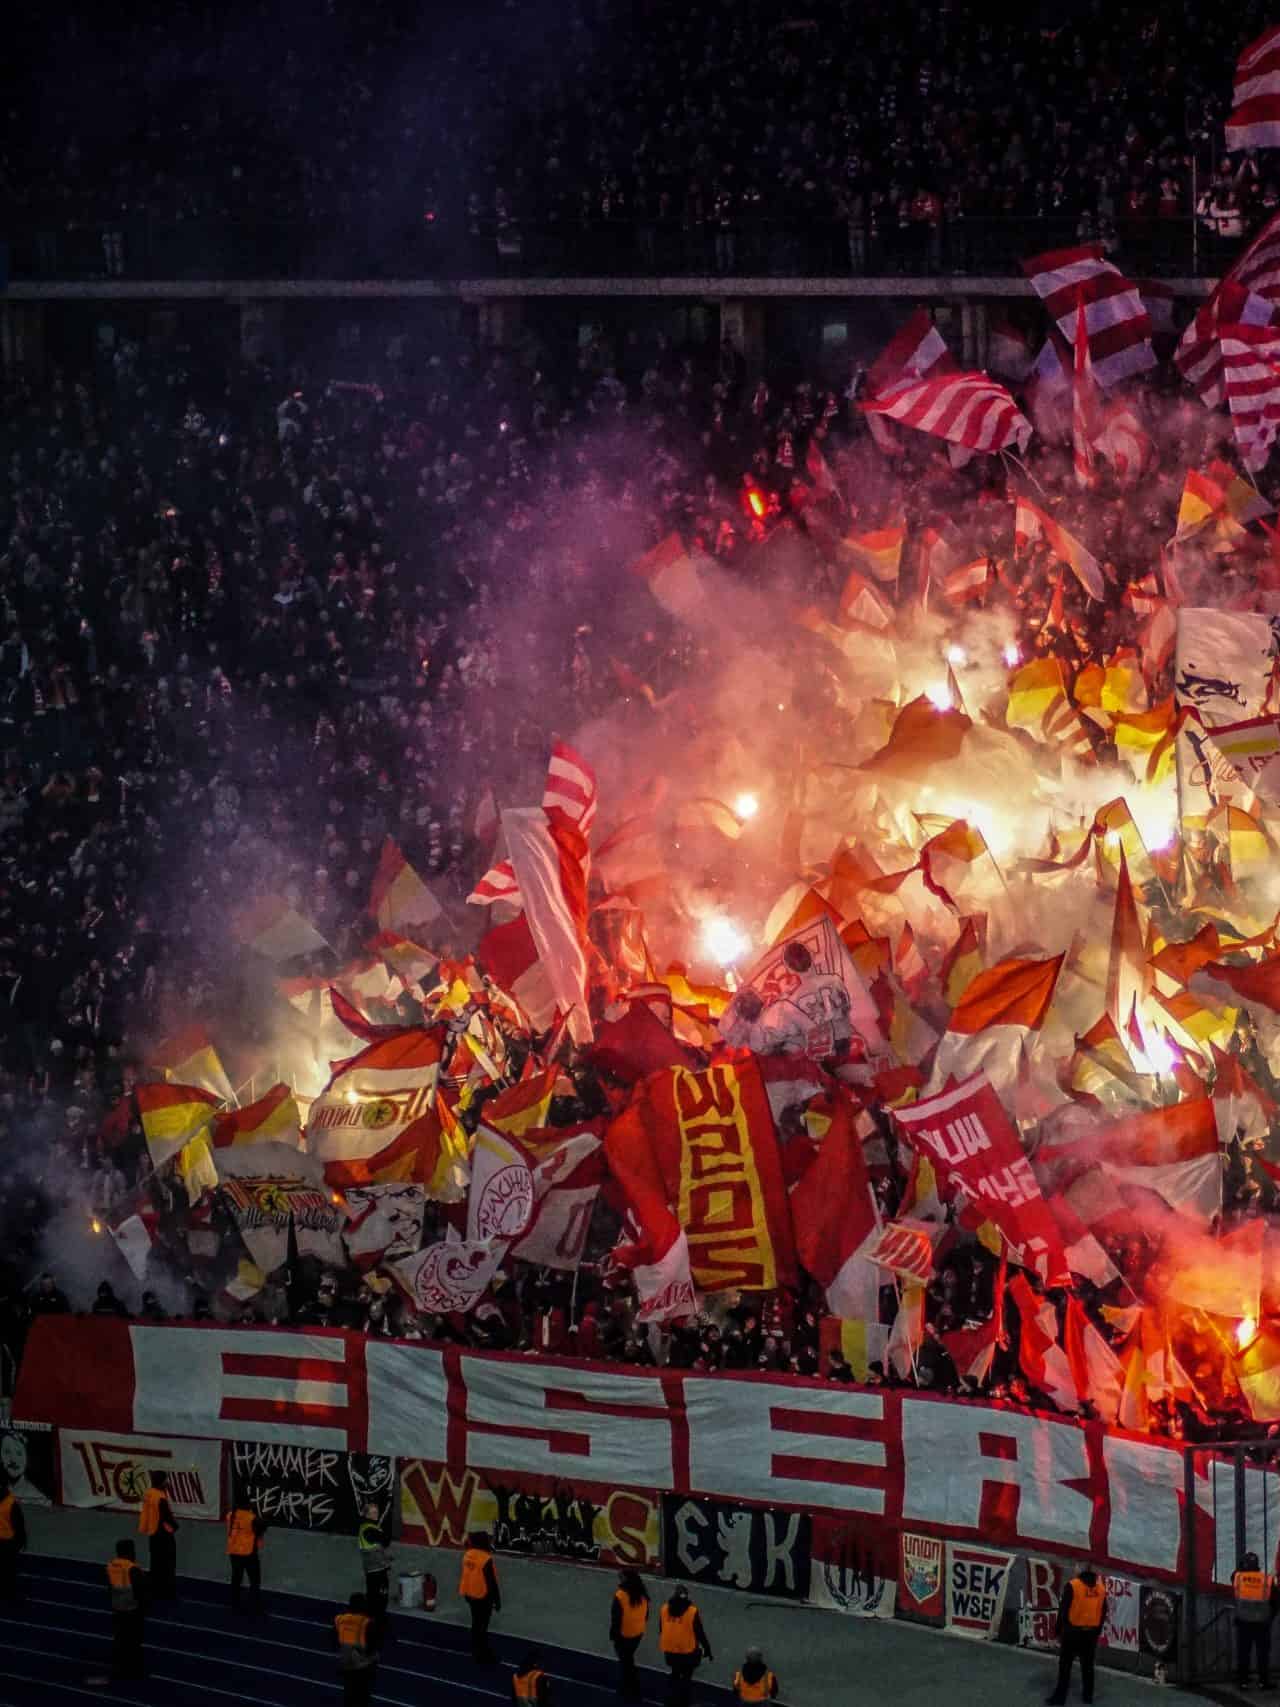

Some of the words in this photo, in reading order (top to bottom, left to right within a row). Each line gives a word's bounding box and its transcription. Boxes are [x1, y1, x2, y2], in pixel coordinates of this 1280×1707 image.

[233, 1442, 339, 1488] HAMMER
[904, 1535, 940, 1561] UNION
[952, 1561, 1005, 1596] SEK
